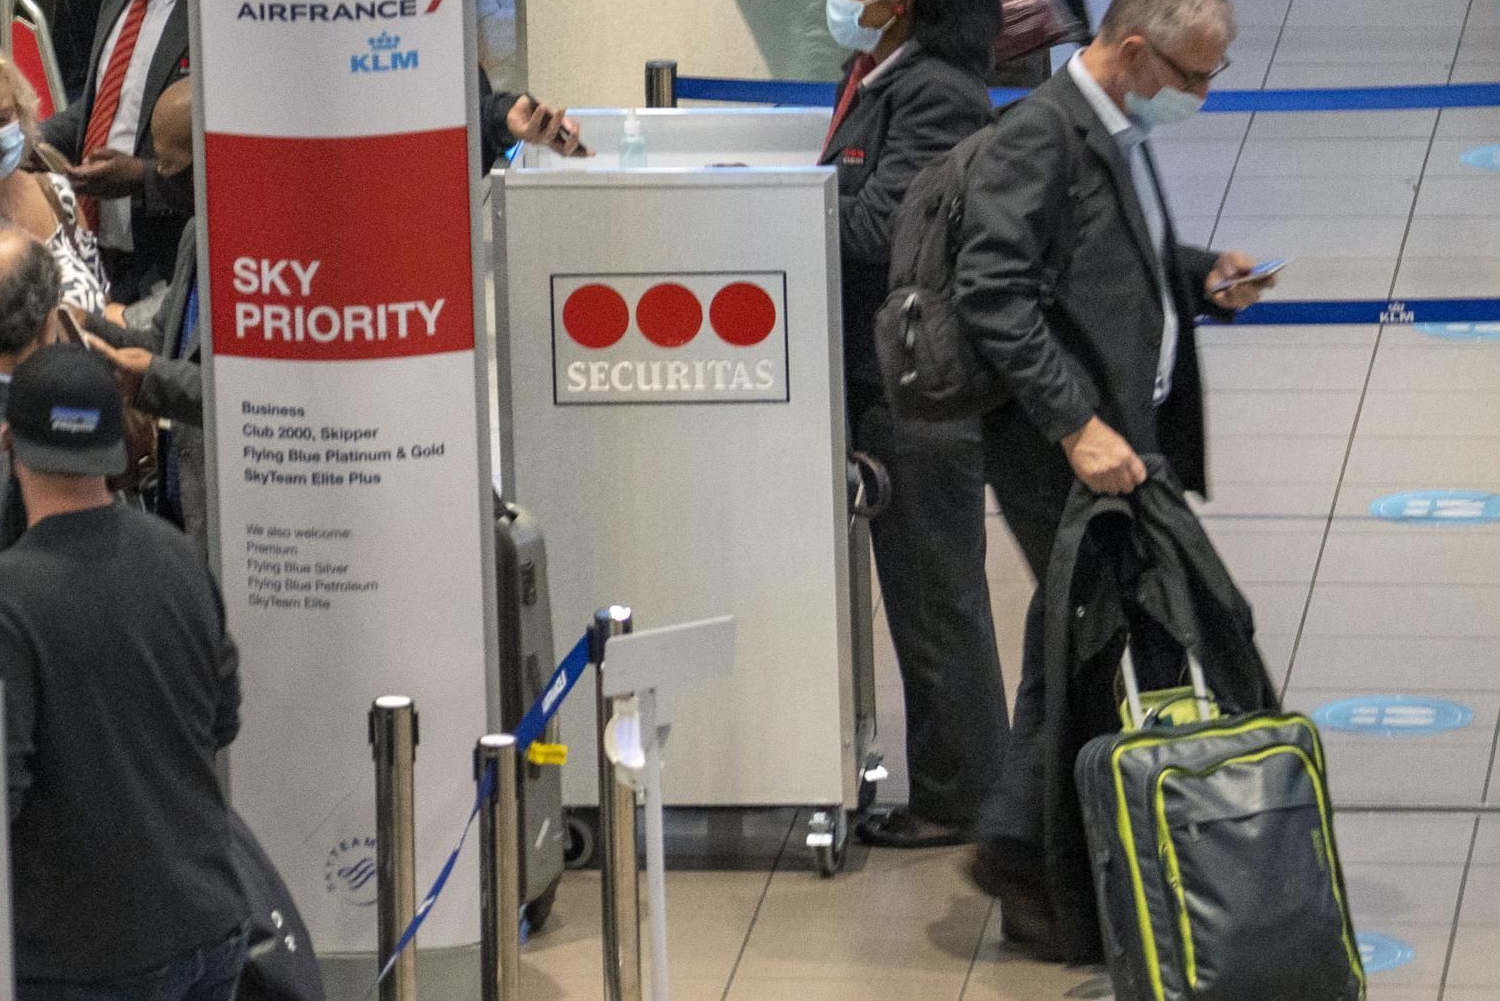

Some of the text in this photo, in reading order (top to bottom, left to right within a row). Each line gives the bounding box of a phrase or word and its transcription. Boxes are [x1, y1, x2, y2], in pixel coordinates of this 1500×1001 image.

[350, 50, 419, 73] KLM
[233, 256, 321, 297] SKY
[235, 298, 446, 343] PRIORITY
[567, 359, 775, 393] SECURITAS
[242, 401, 305, 418] Business
[243, 423, 379, 443] Club 2000, Skipper
[243, 442, 445, 464] Flying Blue Platinum & Gold
[244, 467, 382, 486] SkyTeam Elite Plus
